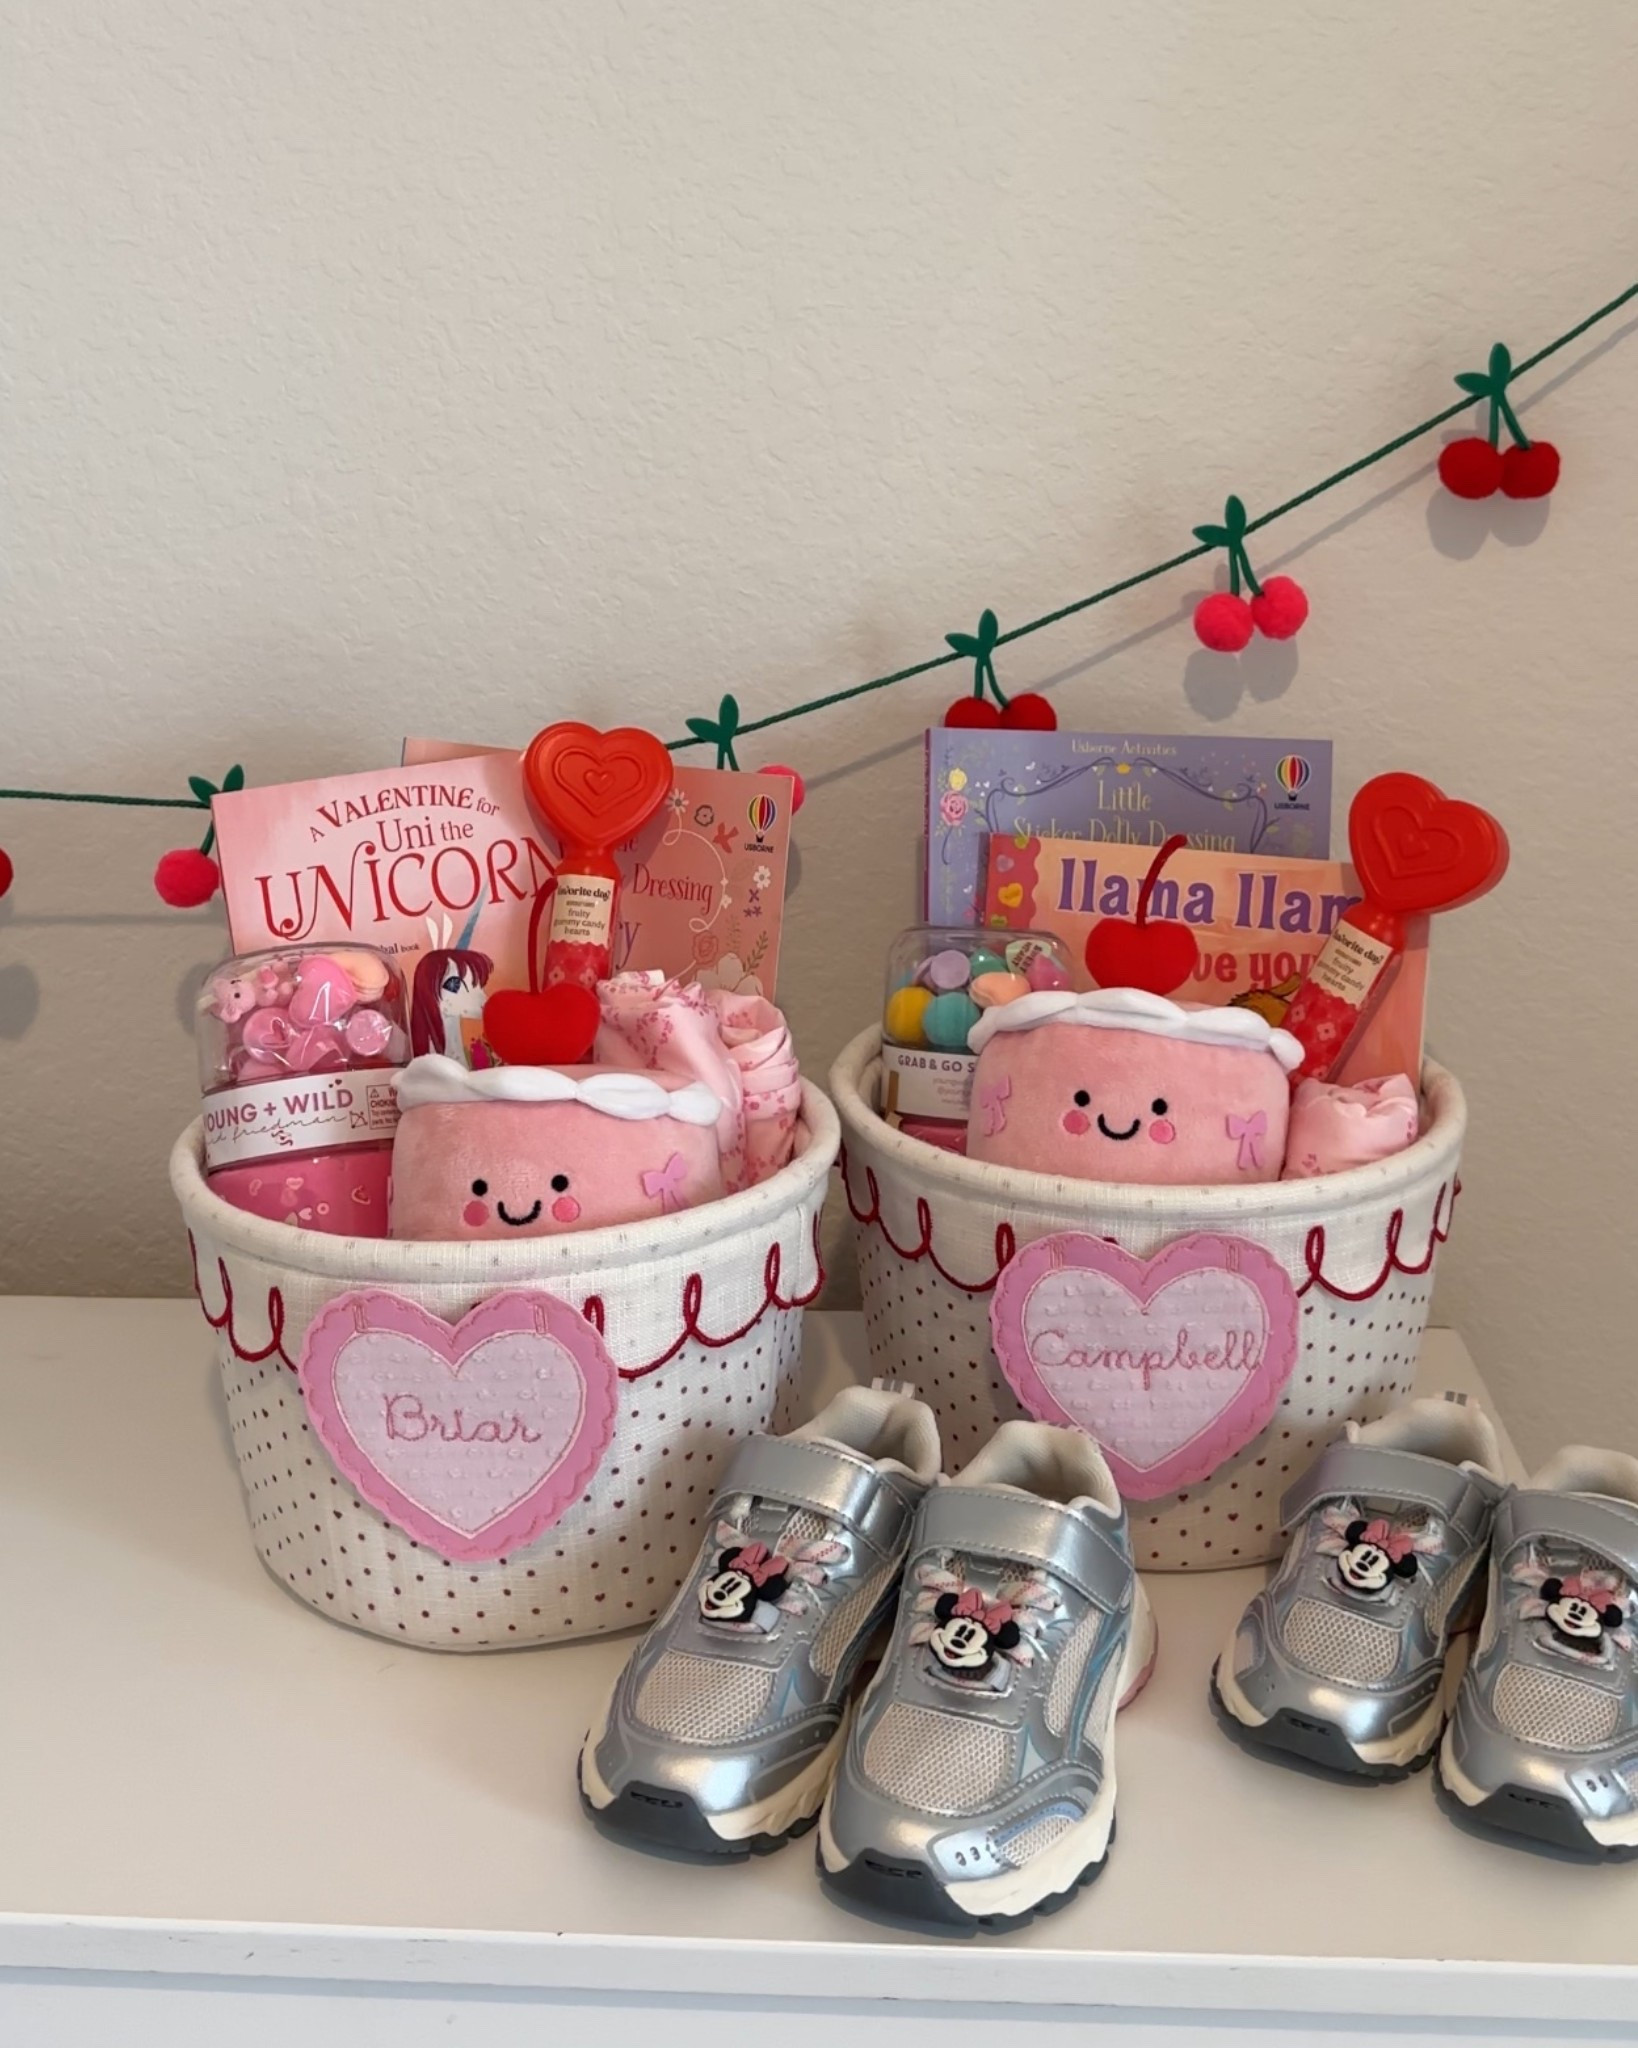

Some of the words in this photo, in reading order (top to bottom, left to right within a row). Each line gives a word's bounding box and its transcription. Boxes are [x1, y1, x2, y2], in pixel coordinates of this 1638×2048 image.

[1071, 739, 1116, 754] Usborne
[1121, 739, 1177, 756] Activities
[1098, 780, 1151, 812] Little
[1274, 802, 1311, 811] USBORNE
[309, 826, 325, 843] A
[317, 785, 474, 828] VALENTINE
[476, 796, 500, 816] for
[377, 816, 436, 852] Uni
[440, 821, 474, 843] the
[744, 843, 774, 853] USBORNE
[632, 863, 714, 916] Dressing
[1057, 857, 1216, 924] llama
[1234, 872, 1363, 936] llam
[897, 1054, 926, 1069] GRAB
[929, 1058, 938, 1071] &
[941, 1060, 963, 1073] GO
[283, 1088, 353, 1117] WILD
[232, 1114, 348, 1144] friedman
[1030, 1328, 1264, 1391] Campbell
[383, 1393, 542, 1443] Briar
